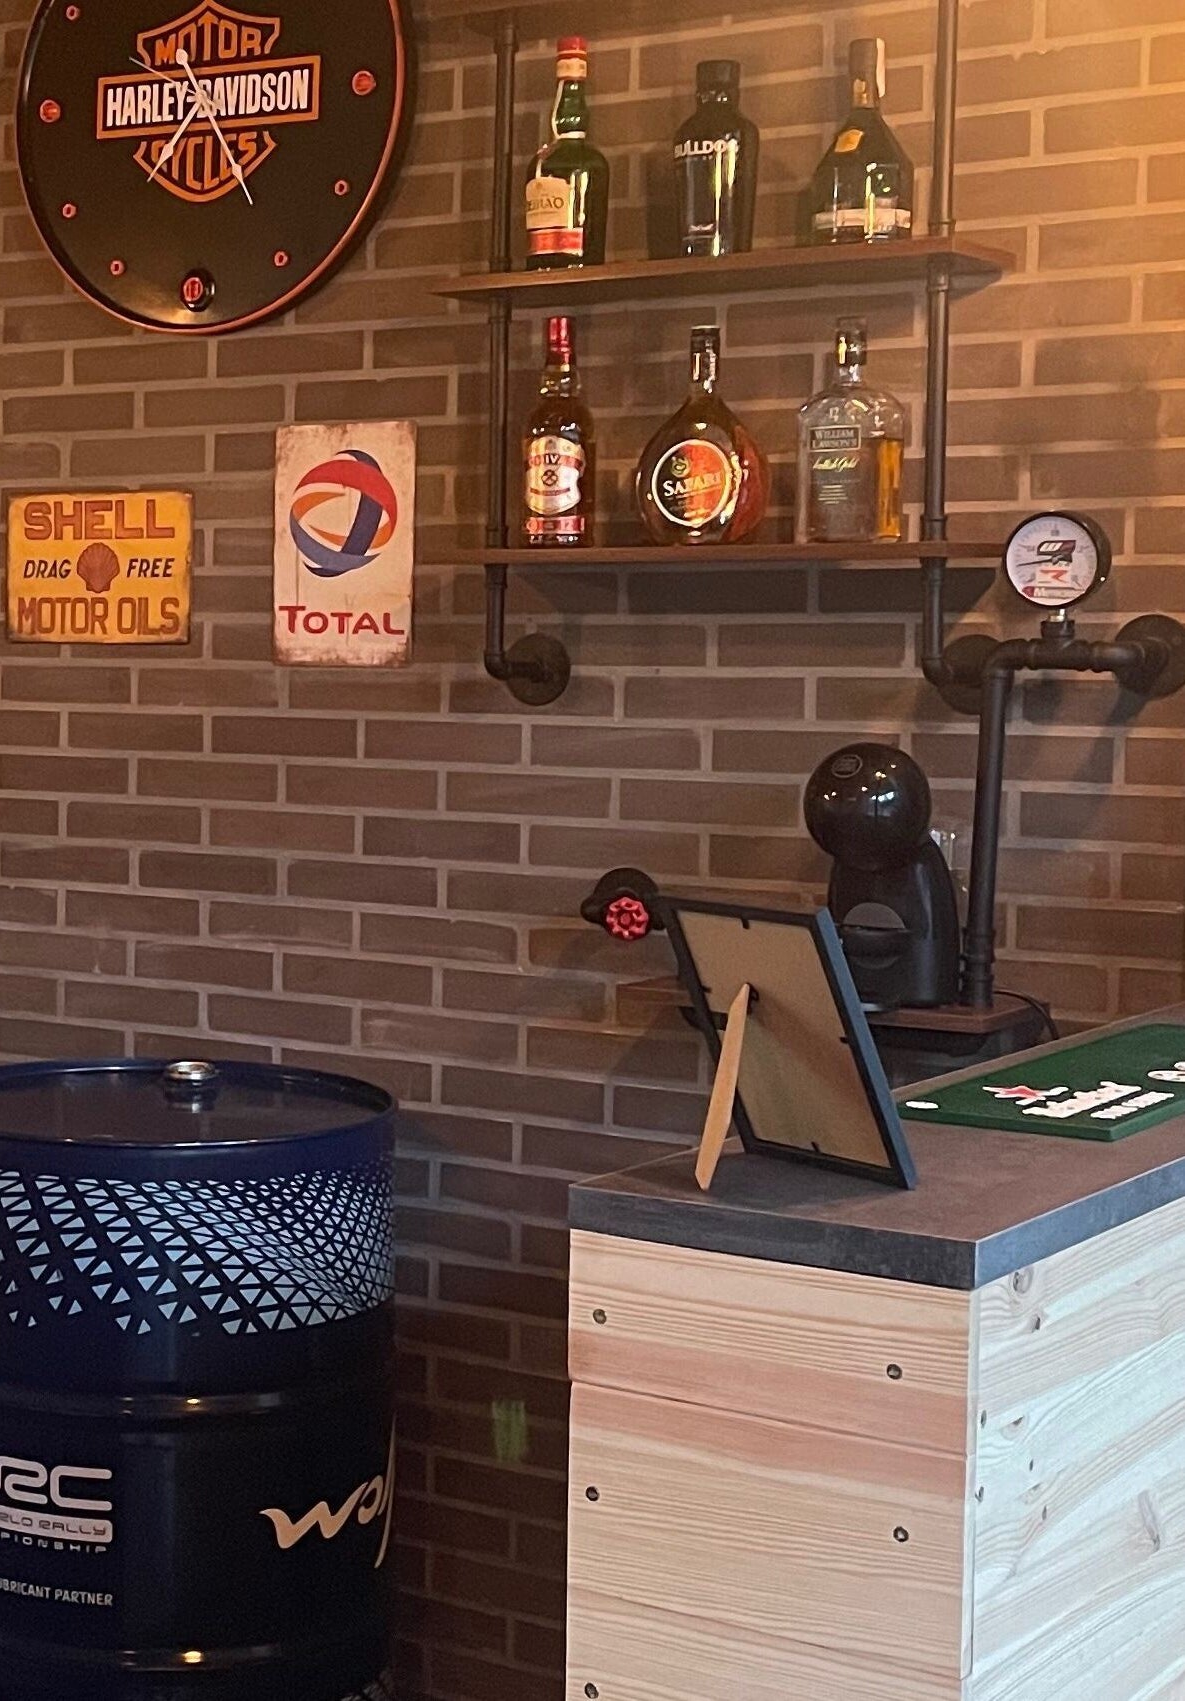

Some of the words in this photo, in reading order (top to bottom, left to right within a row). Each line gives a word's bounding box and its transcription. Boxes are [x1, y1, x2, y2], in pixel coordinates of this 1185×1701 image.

[155, 11, 261, 66] MOTOR
[150, 131, 257, 190] CYCLES
[24, 499, 176, 541] SHELL
[23, 559, 72, 579] DRAG
[126, 557, 176, 578] FREE
[17, 597, 109, 636] MOTOR
[117, 597, 180, 636] OILS
[278, 605, 405, 635] TOTAL
[39, 1519, 106, 1536] RALLY
[54, 1588, 113, 1606] PARTNER
